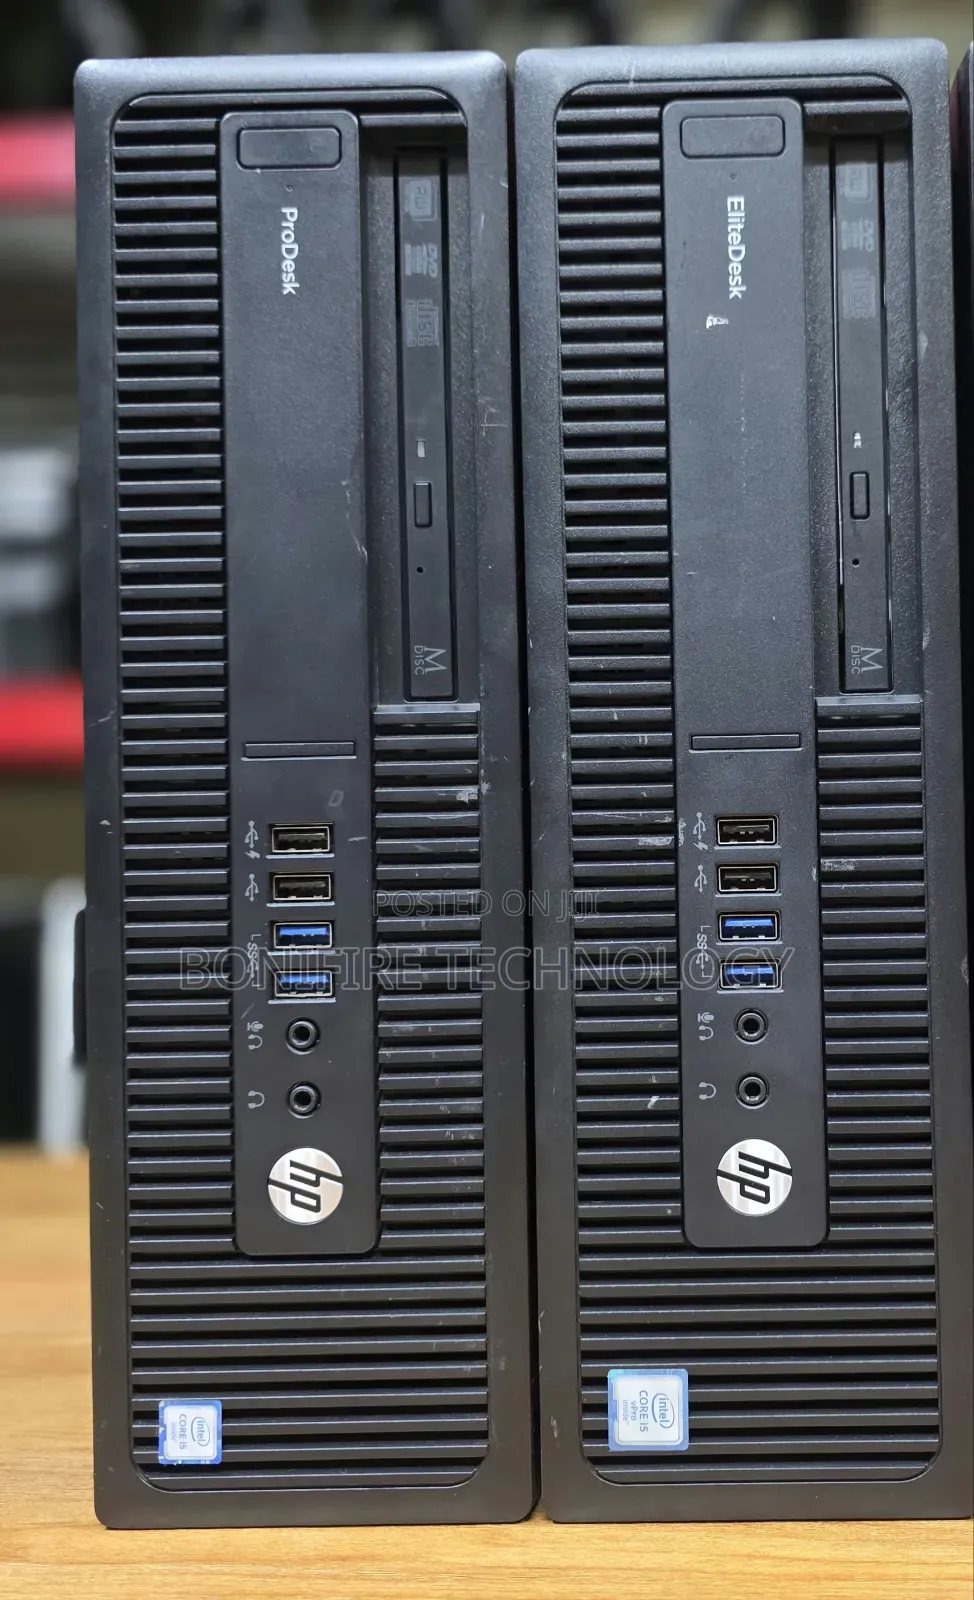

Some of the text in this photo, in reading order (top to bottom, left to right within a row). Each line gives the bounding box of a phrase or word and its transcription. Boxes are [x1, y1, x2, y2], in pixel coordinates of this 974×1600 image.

[281, 207, 300, 296] ProDesk
[427, 243, 439, 278] DVD
[727, 195, 747, 300] EliteDesk
[414, 645, 424, 676] DISC
[424, 645, 447, 675] M
[850, 645, 861, 675] DISC
[860, 645, 884, 674] M
[267, 1147, 344, 1224] hp
[717, 1139, 793, 1216] hp
[630, 1400, 639, 1421] vPro
[639, 1389, 649, 1432] CORE i5
[658, 1397, 671, 1423] intel
[179, 1413, 188, 1450] CORE i5
